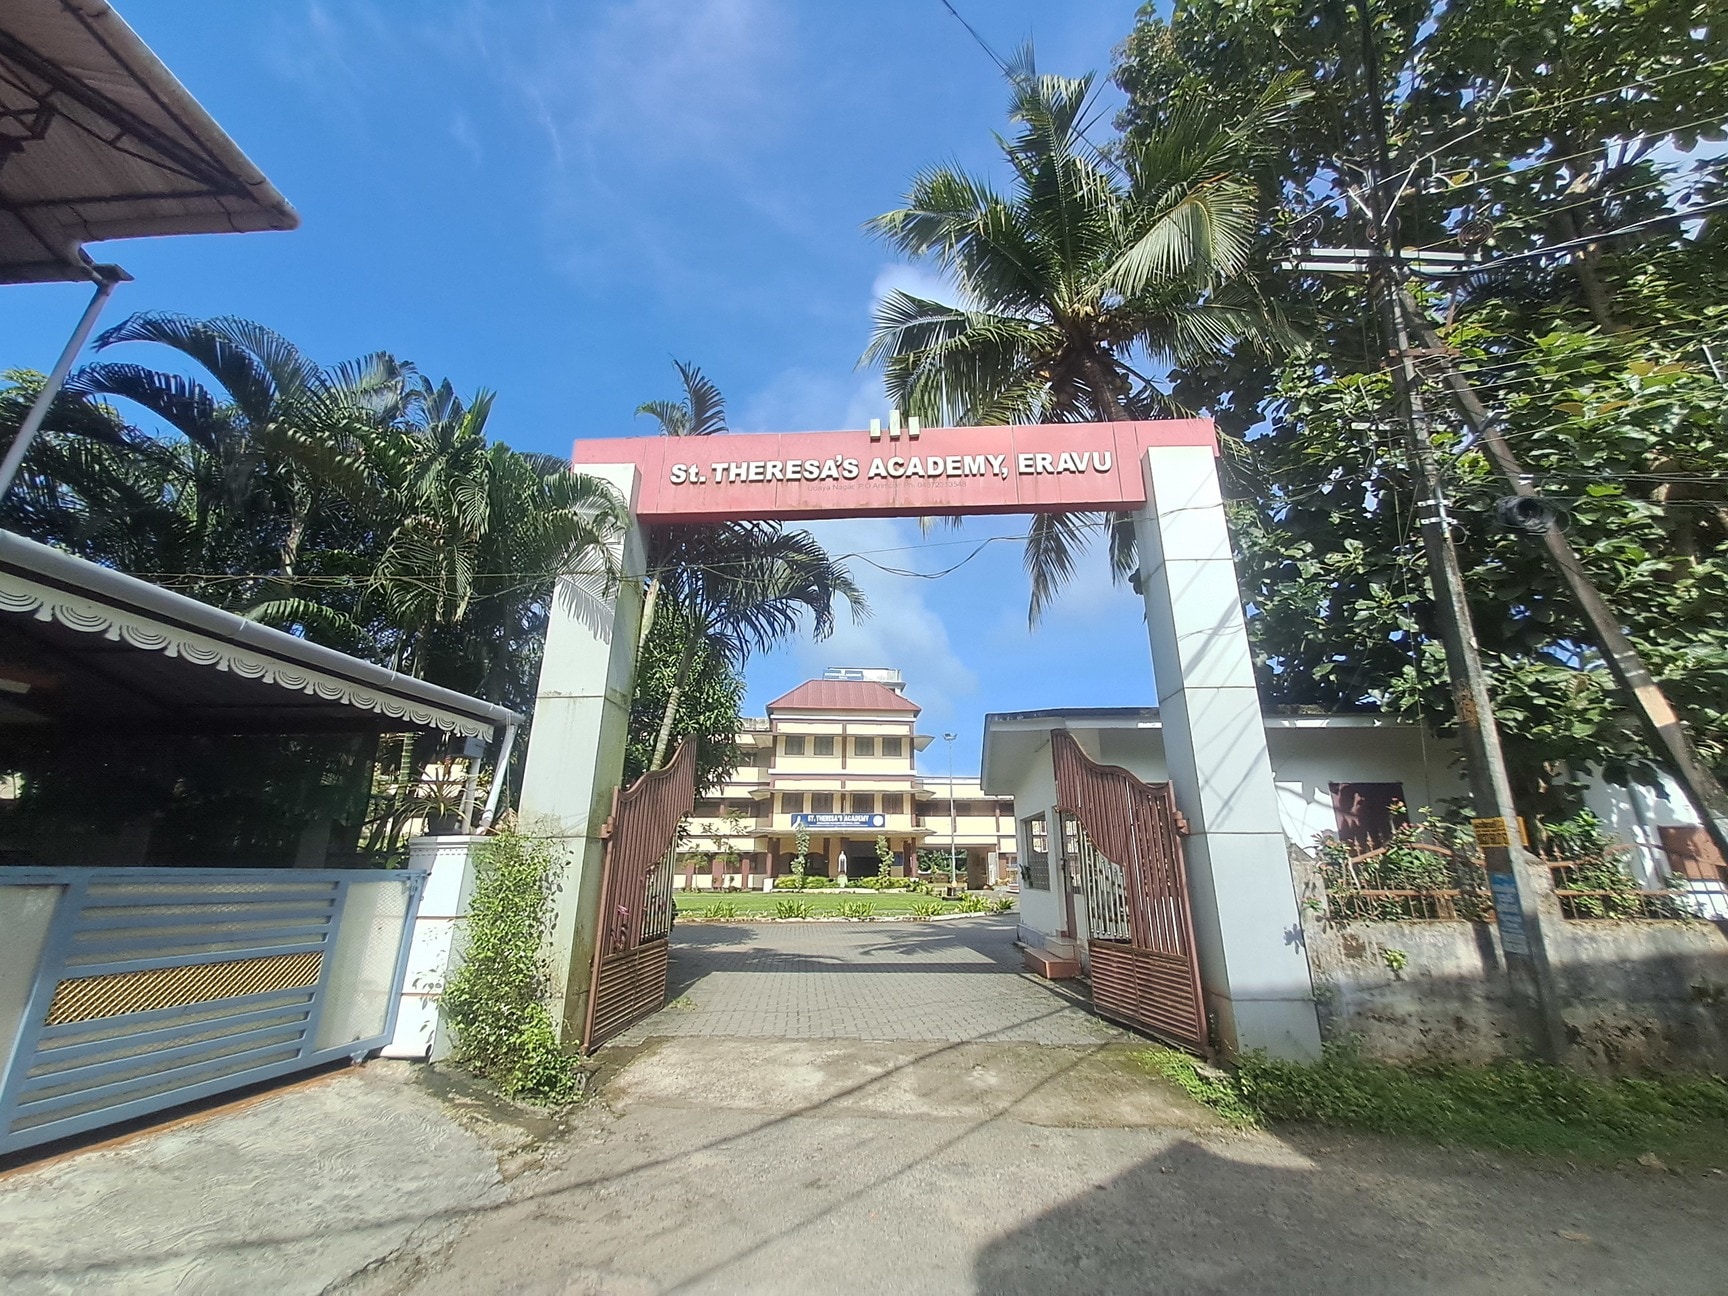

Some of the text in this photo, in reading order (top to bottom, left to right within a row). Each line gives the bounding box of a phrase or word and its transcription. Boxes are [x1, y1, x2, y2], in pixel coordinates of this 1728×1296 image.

[669, 450, 1113, 485] St. THERESA'S ACADEMY, ERAVU
